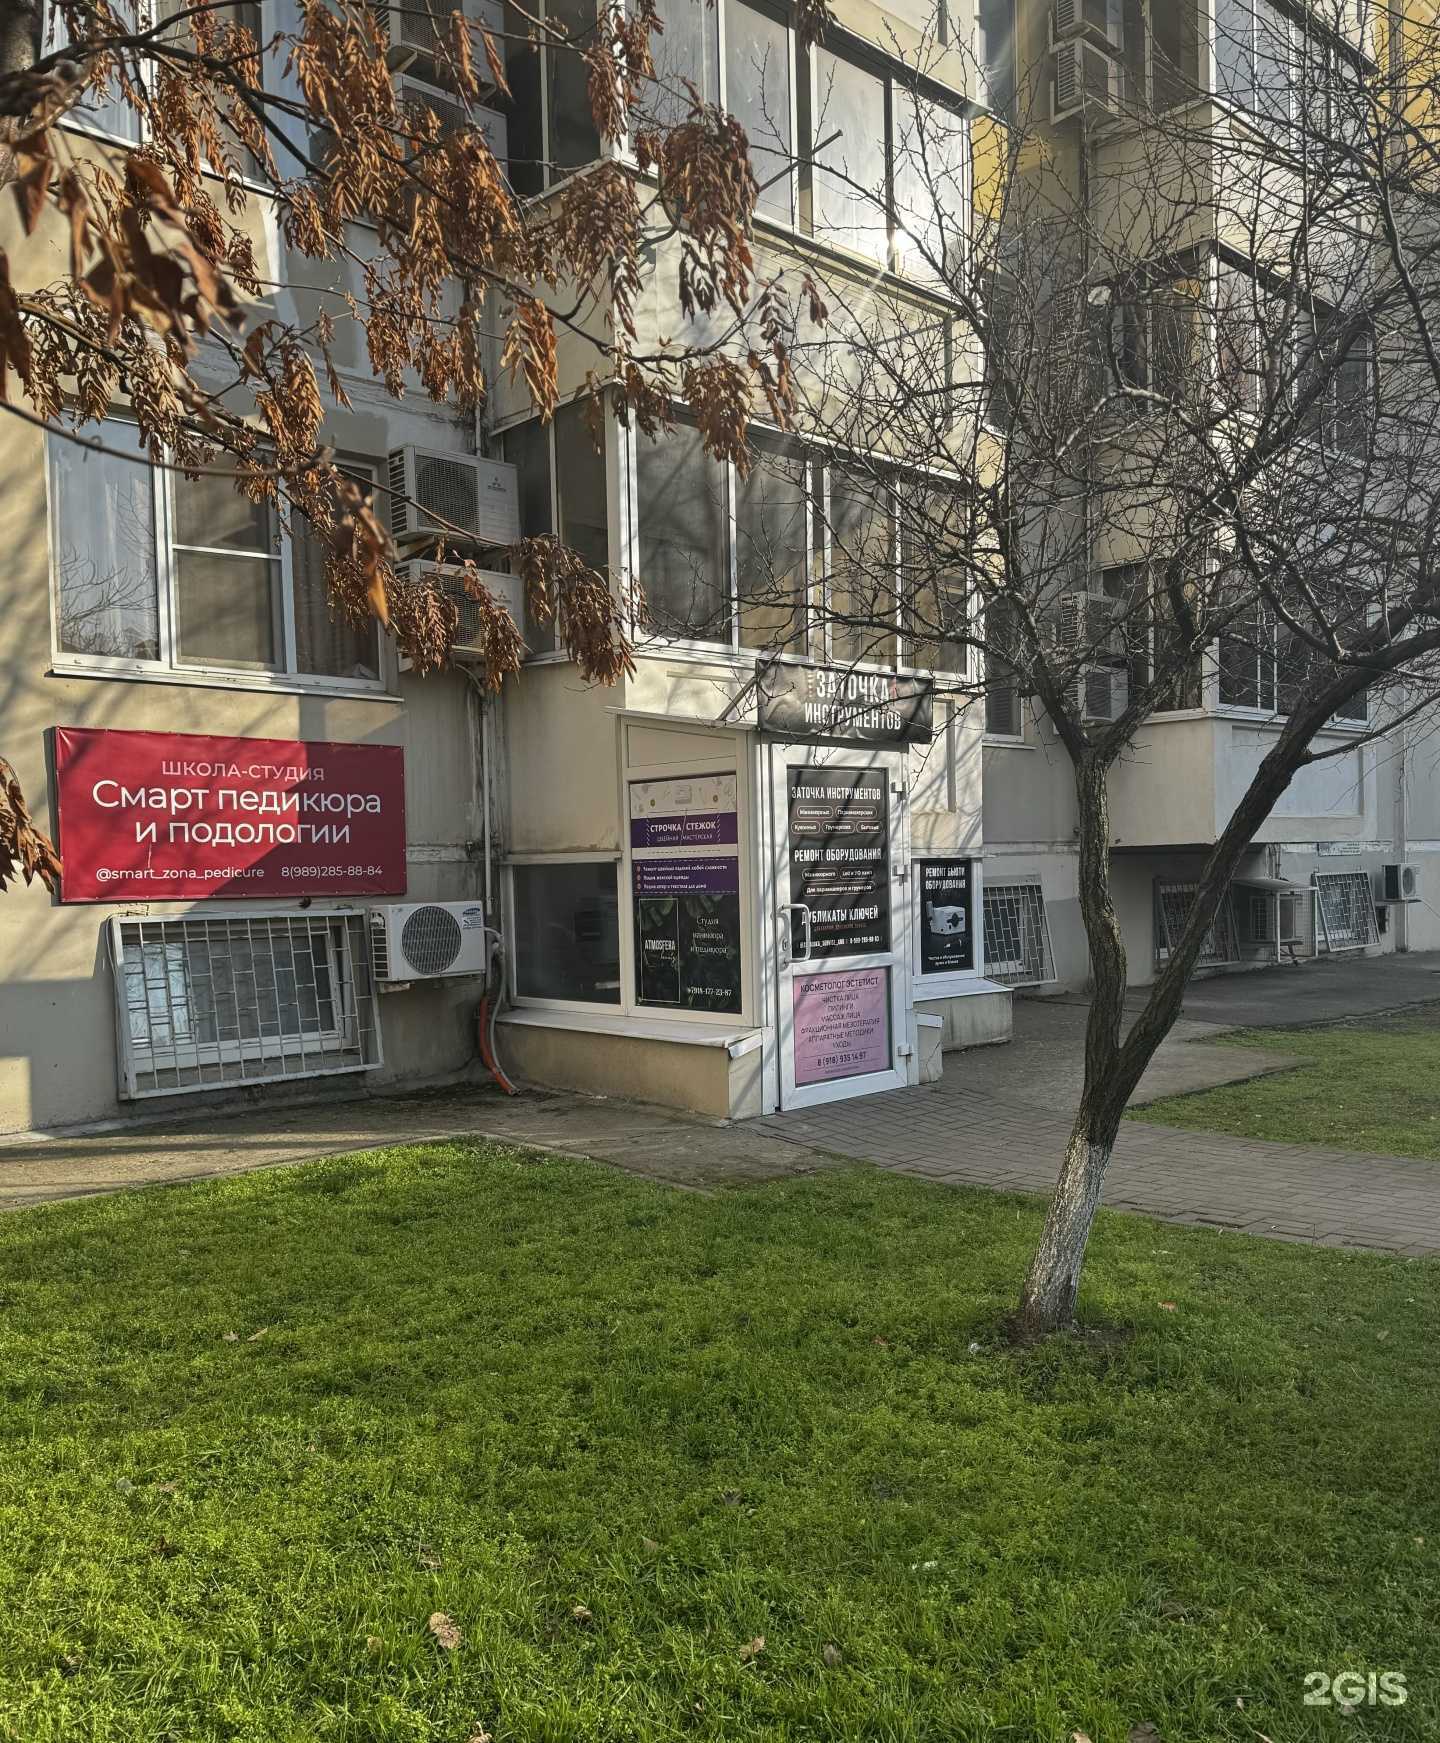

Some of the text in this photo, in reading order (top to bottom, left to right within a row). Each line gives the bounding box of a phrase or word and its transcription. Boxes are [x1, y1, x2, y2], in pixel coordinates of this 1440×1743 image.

[816, 670, 889, 703] ЗАТОЧКА
[805, 702, 901, 730] ИНСТРУМЕНТОВ
[161, 761, 325, 782] ШКОЛА-СТУДИЯ
[92, 780, 382, 818] Смарт педикюра
[791, 786, 881, 800] ЗАТОЧКА ИНСТРУМЕНТОВ
[135, 822, 351, 847] и подологии
[650, 820, 717, 833] СТРОЧКА СТЕЖОК
[794, 847, 882, 862] РЕМОНТ ОБОРУДОВАНИЯ
[96, 865, 384, 882] @smart_zona_pedicure 8(989)285-88-84
[925, 867, 946, 877] РЕМОНТ
[925, 879, 966, 890] ОБОРУДОВАНИЯ
[849, 905, 879, 922] КЛЮЧЕЙ
[645, 939, 676, 951] ATMOSFERA
[800, 976, 879, 993] КОСМЕТОЛОГ ЭСТЕТИСТ
